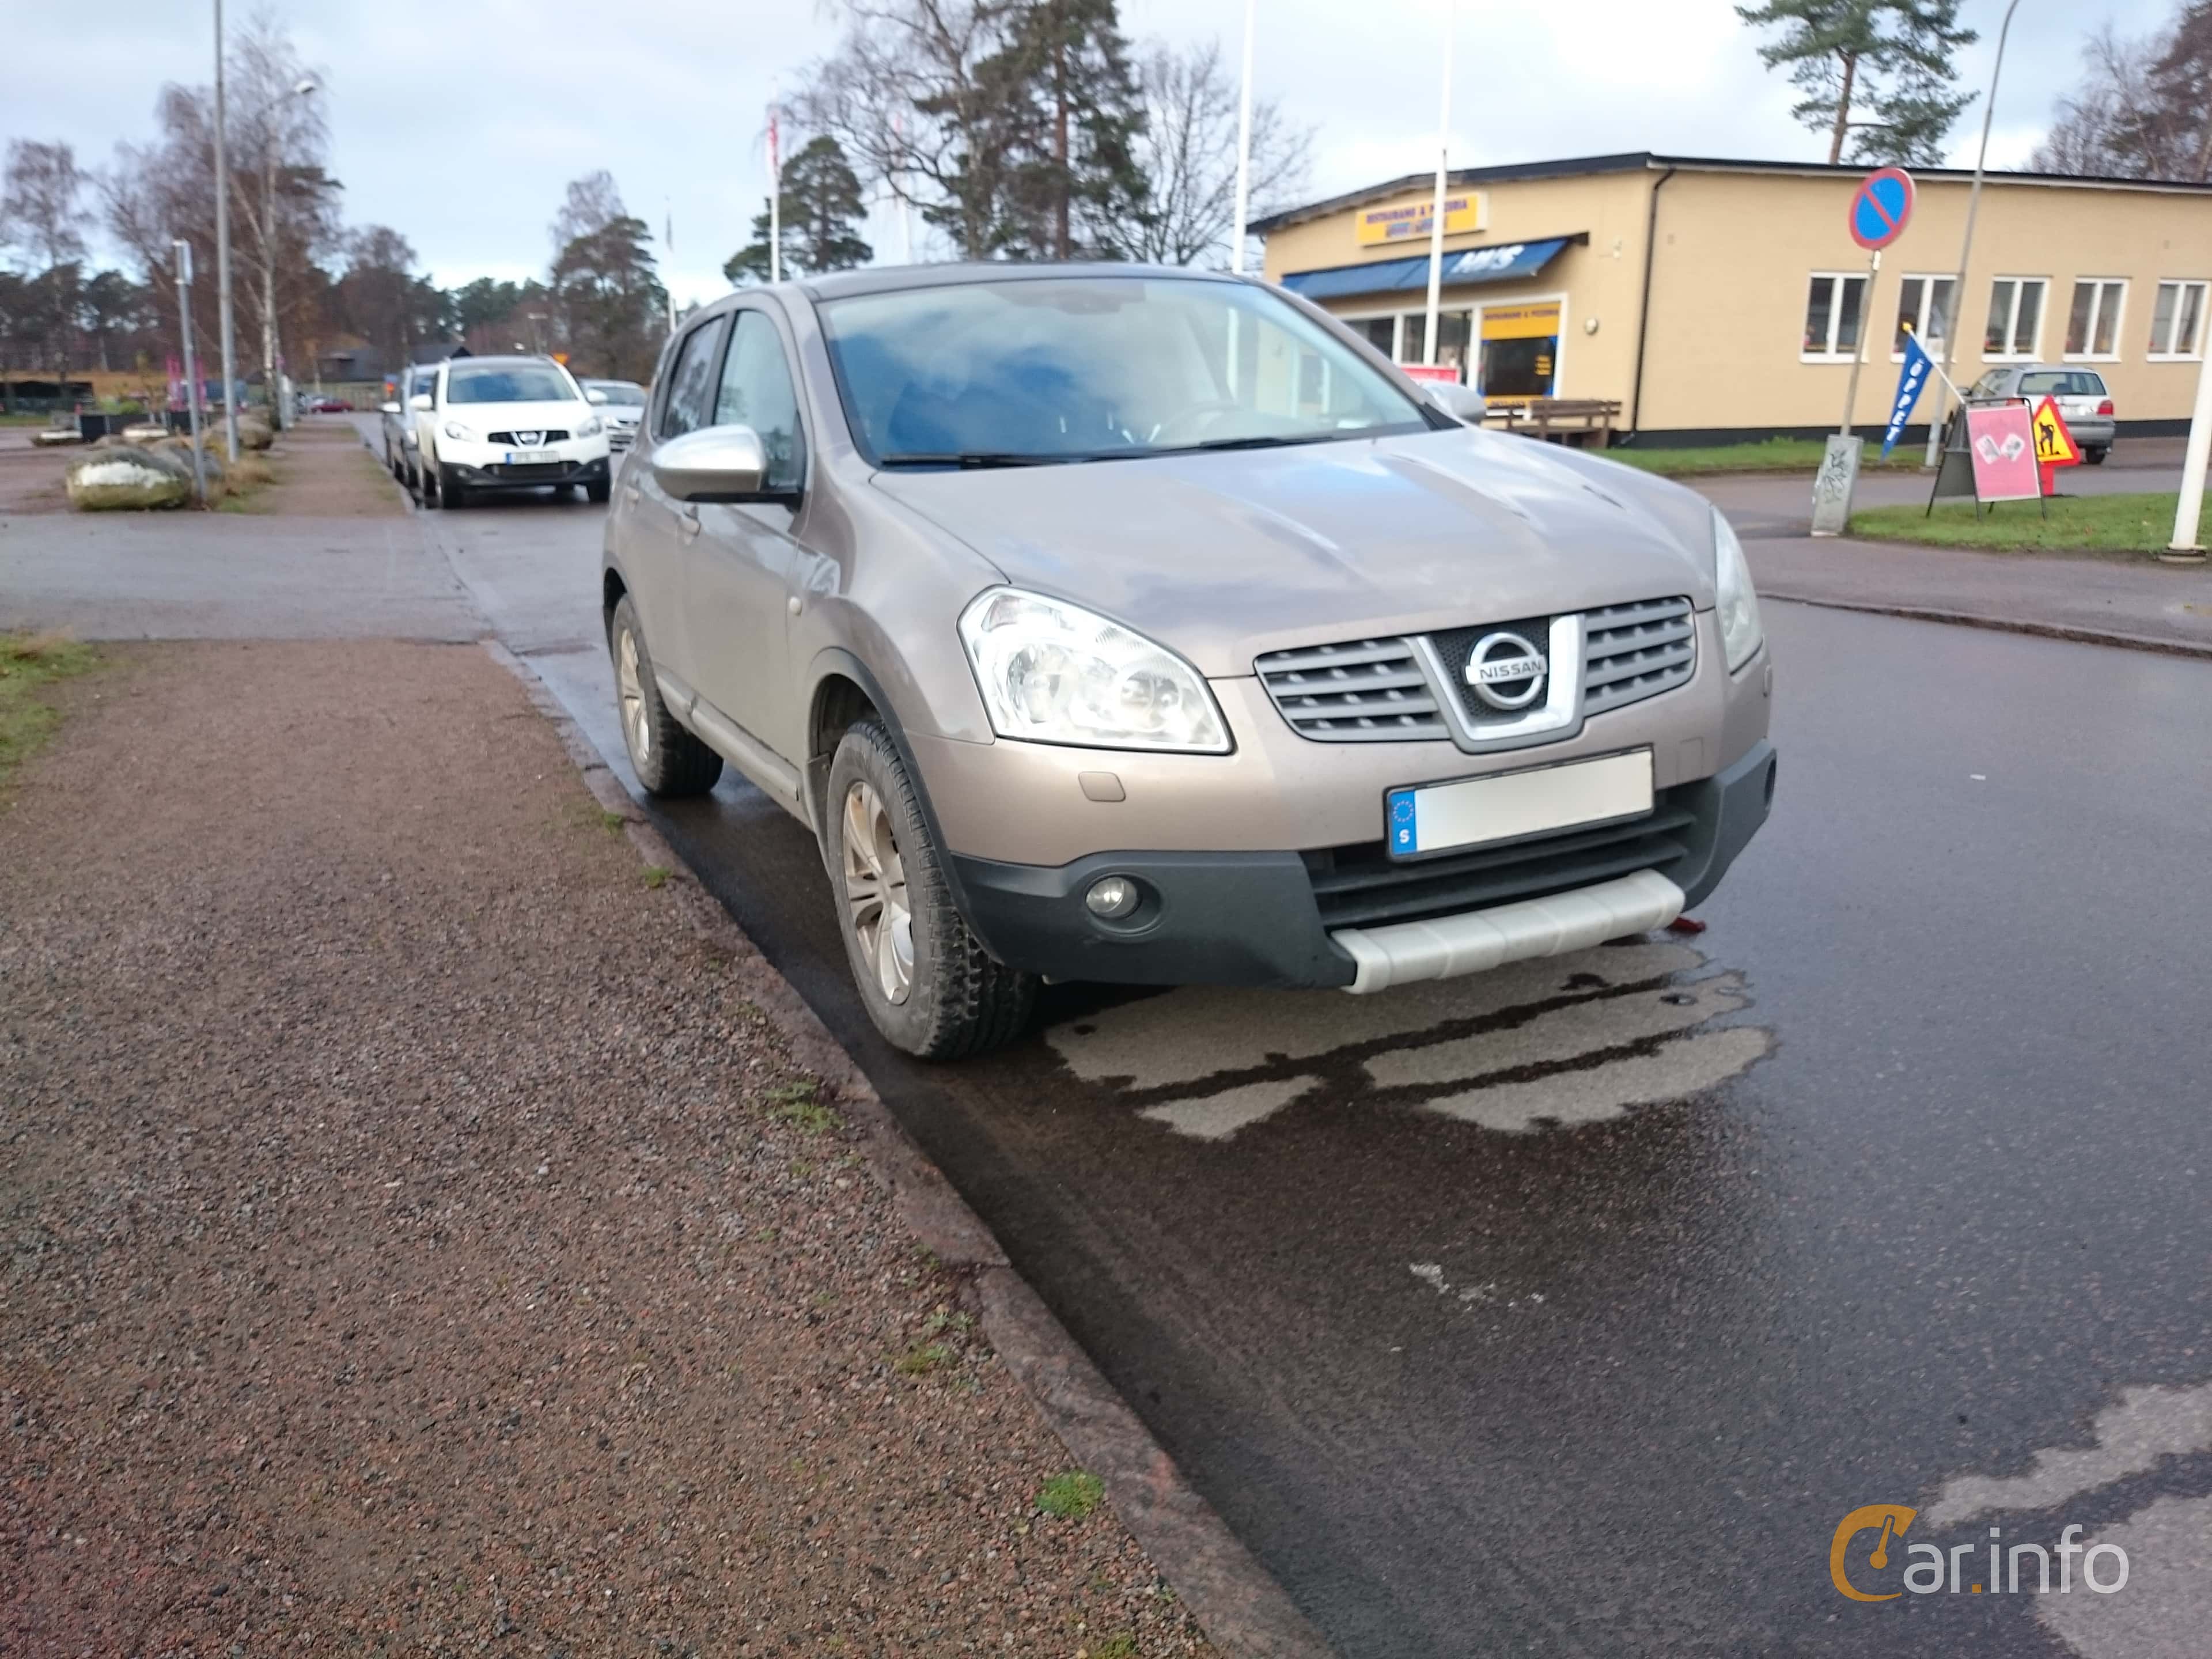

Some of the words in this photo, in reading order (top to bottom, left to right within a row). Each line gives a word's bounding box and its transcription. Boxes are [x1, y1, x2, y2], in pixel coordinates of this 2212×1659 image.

[1887, 358, 1925, 441] ÖPPET
[1479, 661, 1541, 679] NISSAN
[1399, 829, 1410, 844] S
